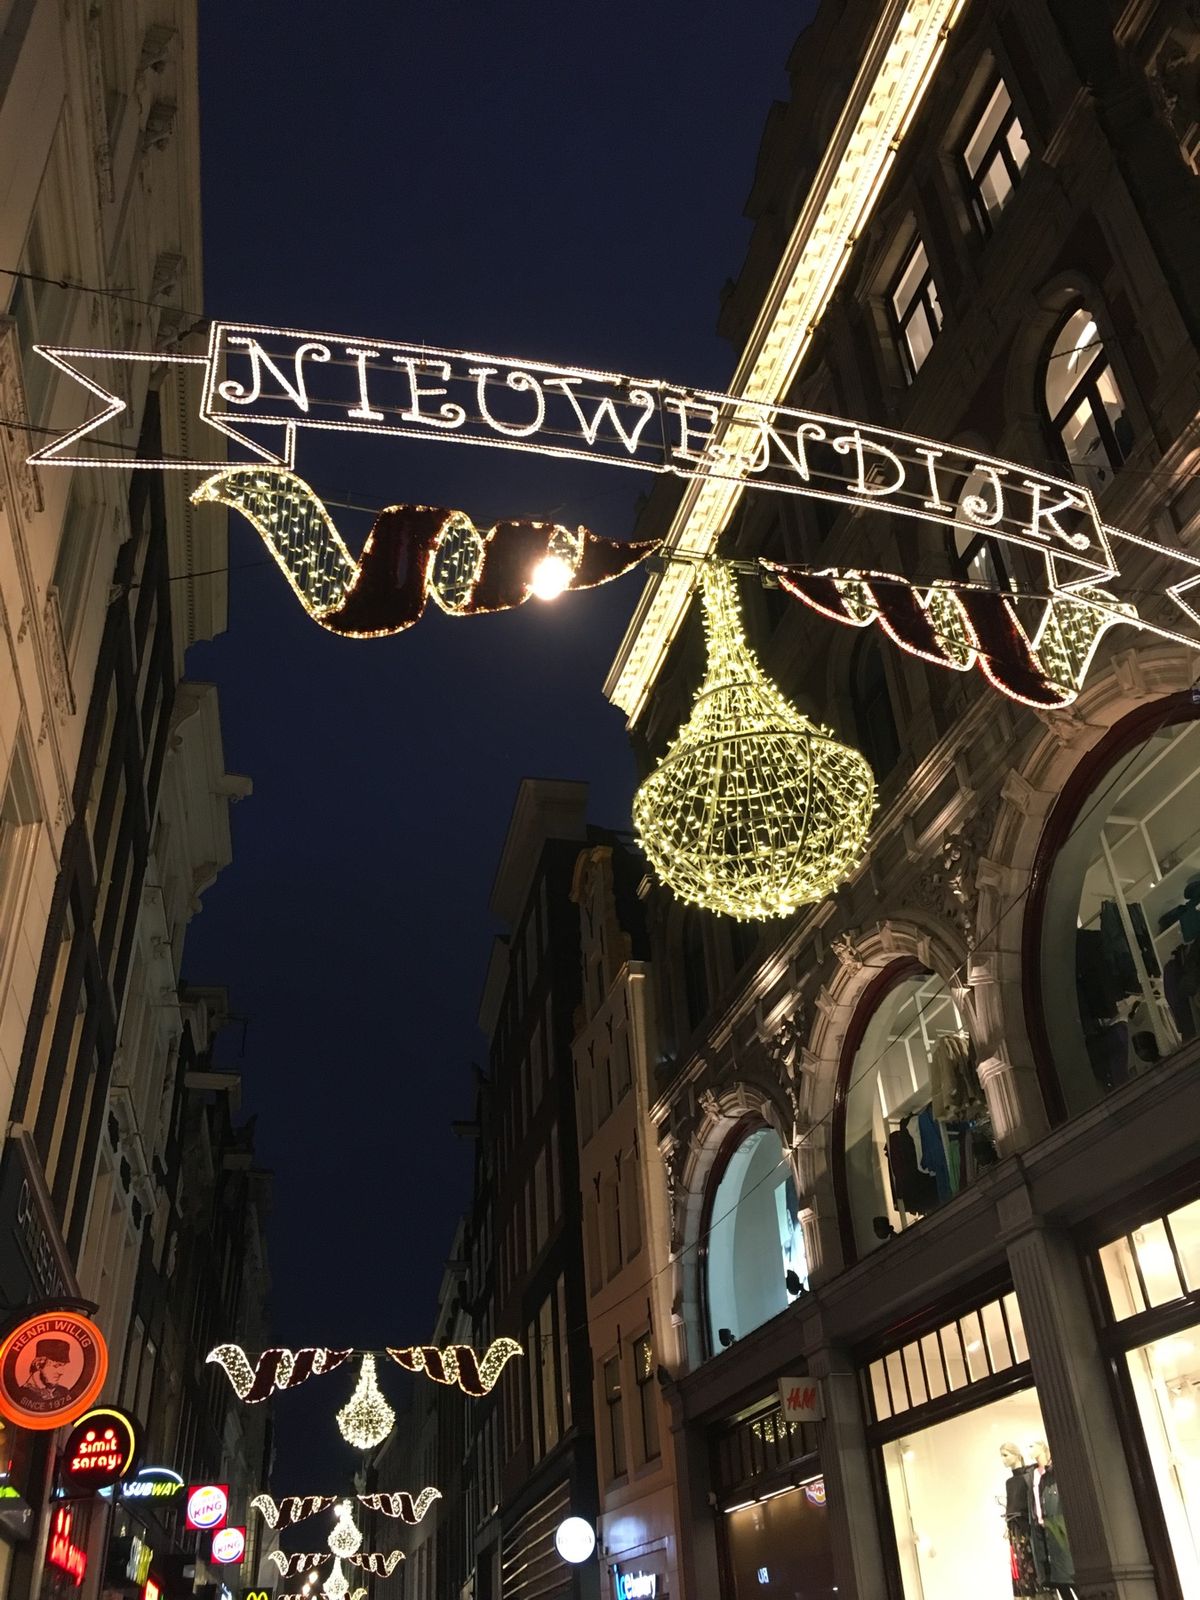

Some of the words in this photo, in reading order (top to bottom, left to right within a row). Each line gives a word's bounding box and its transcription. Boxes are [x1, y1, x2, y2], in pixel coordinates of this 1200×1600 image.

[217, 334, 1092, 550] NIEUWENDIJK
[12, 1322, 50, 1352] HENRI
[55, 1320, 92, 1348] WILLIG
[20, 1397, 46, 1409] SINCE
[79, 1435, 117, 1454] simit
[122, 1481, 181, 1497] SUBWAY
[193, 1501, 222, 1519] KING
